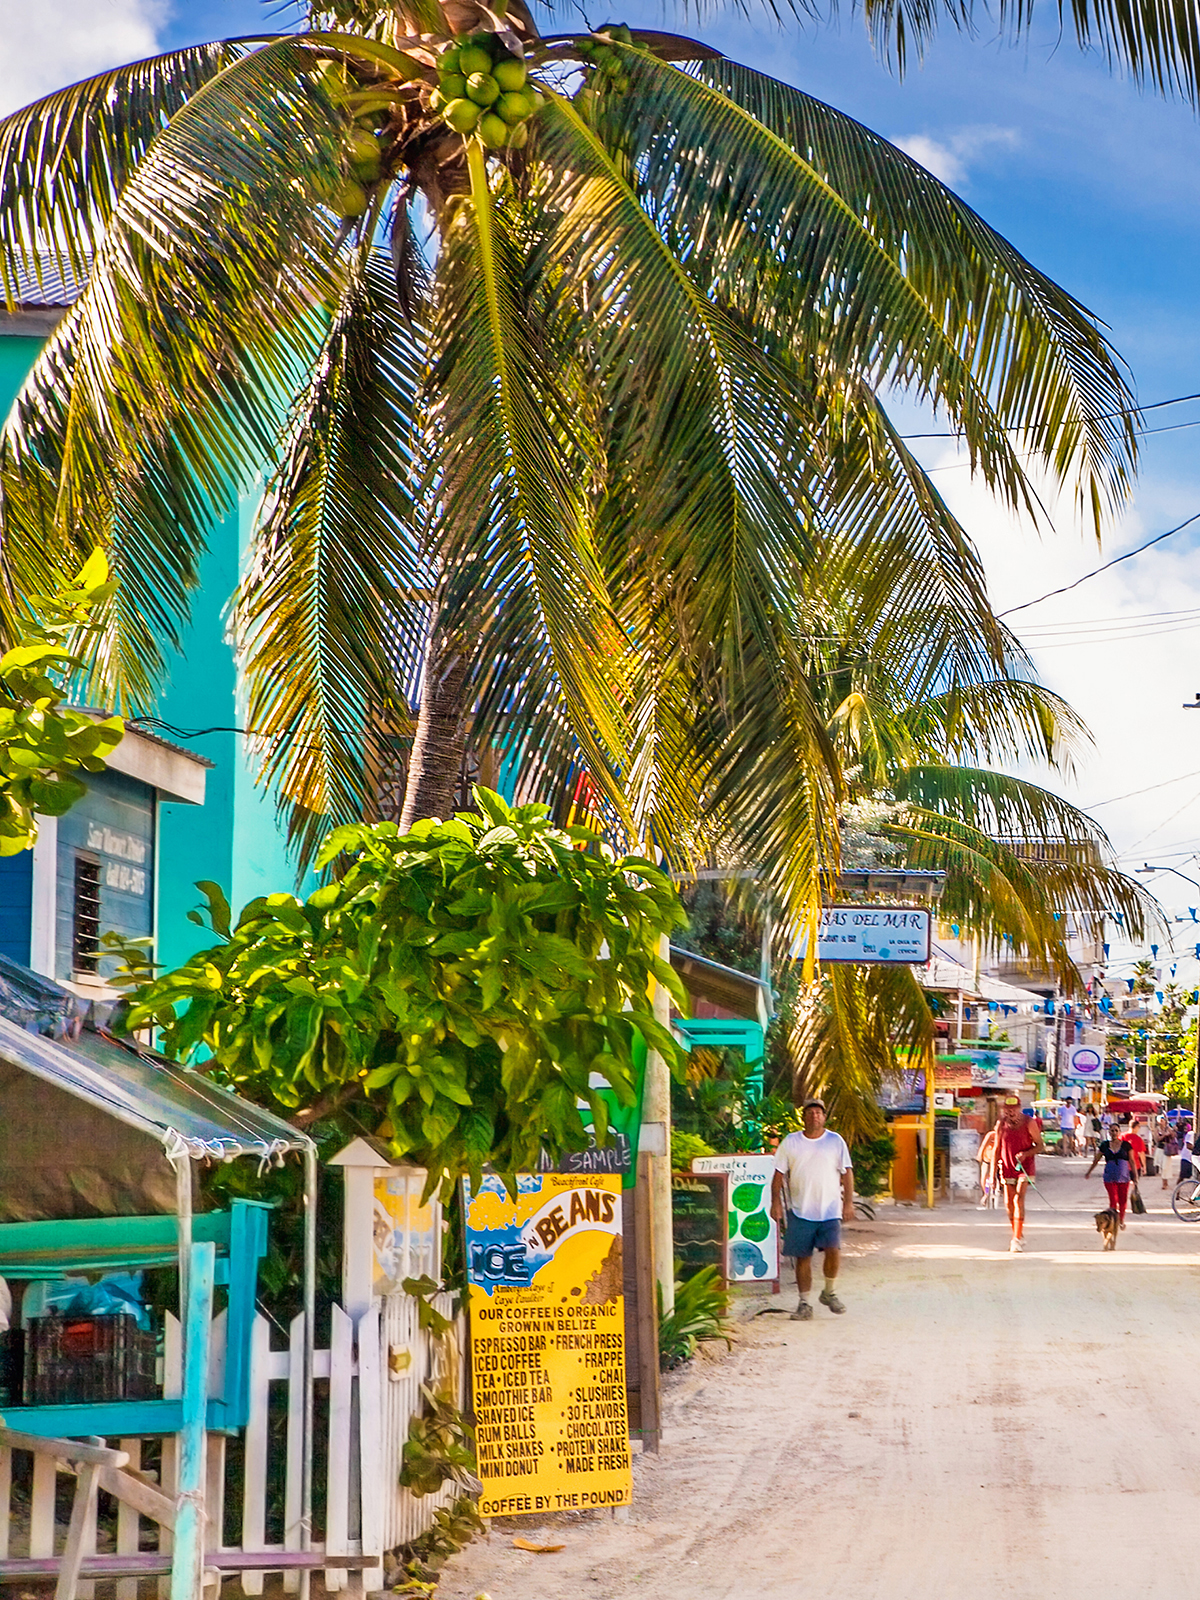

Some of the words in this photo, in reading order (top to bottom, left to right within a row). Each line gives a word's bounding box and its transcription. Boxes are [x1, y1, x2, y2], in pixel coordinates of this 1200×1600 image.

[852, 913, 879, 927] DEL
[882, 913, 923, 930] MAR
[568, 1148, 632, 1172] SAMPLE
[697, 1158, 748, 1171] Manatee
[471, 1242, 530, 1283] ICE
[534, 1189, 617, 1250] BEANS
[479, 1309, 503, 1320] OUR
[506, 1307, 551, 1318] COFFEE
[554, 1307, 563, 1317] IS
[567, 1306, 616, 1317] ORGANIC
[499, 1321, 540, 1332] GROWN
[543, 1321, 554, 1331] IN
[558, 1319, 596, 1331] BELIZE
[474, 1336, 526, 1354] ESPRESSO
[529, 1335, 546, 1350] BAR
[556, 1334, 592, 1350] FRENCH
[594, 1333, 622, 1349] PRESS
[474, 1355, 498, 1372] ICED
[501, 1353, 541, 1370] COFFEE
[585, 1352, 623, 1368] FRAPPE
[475, 1374, 495, 1389] TEA
[504, 1372, 526, 1387] ICED
[530, 1370, 550, 1385] TEA
[600, 1369, 623, 1383] CHAI
[476, 1389, 529, 1407] SMOOTHIE
[532, 1387, 552, 1403] BAR
[576, 1386, 624, 1402] SLUSHIES
[477, 1408, 516, 1425] SHAVED
[518, 1406, 534, 1422] ICE
[568, 1406, 580, 1420] 30
[583, 1403, 625, 1420] FLAVORS
[478, 1426, 501, 1443] RUM
[504, 1424, 536, 1441] BALLS
[567, 1421, 626, 1438] CHOCOLATES
[479, 1444, 504, 1461] MILK
[507, 1441, 544, 1458] SHAKES
[557, 1440, 595, 1457] PROTEIN
[598, 1438, 626, 1454] SHAKE
[480, 1462, 503, 1479] MINI
[506, 1459, 538, 1477] DONUT
[566, 1457, 594, 1473] MADE
[598, 1454, 628, 1470] FRESH
[483, 1497, 531, 1514] COFFEE
[536, 1495, 553, 1509] BY
[556, 1493, 578, 1507] THE
